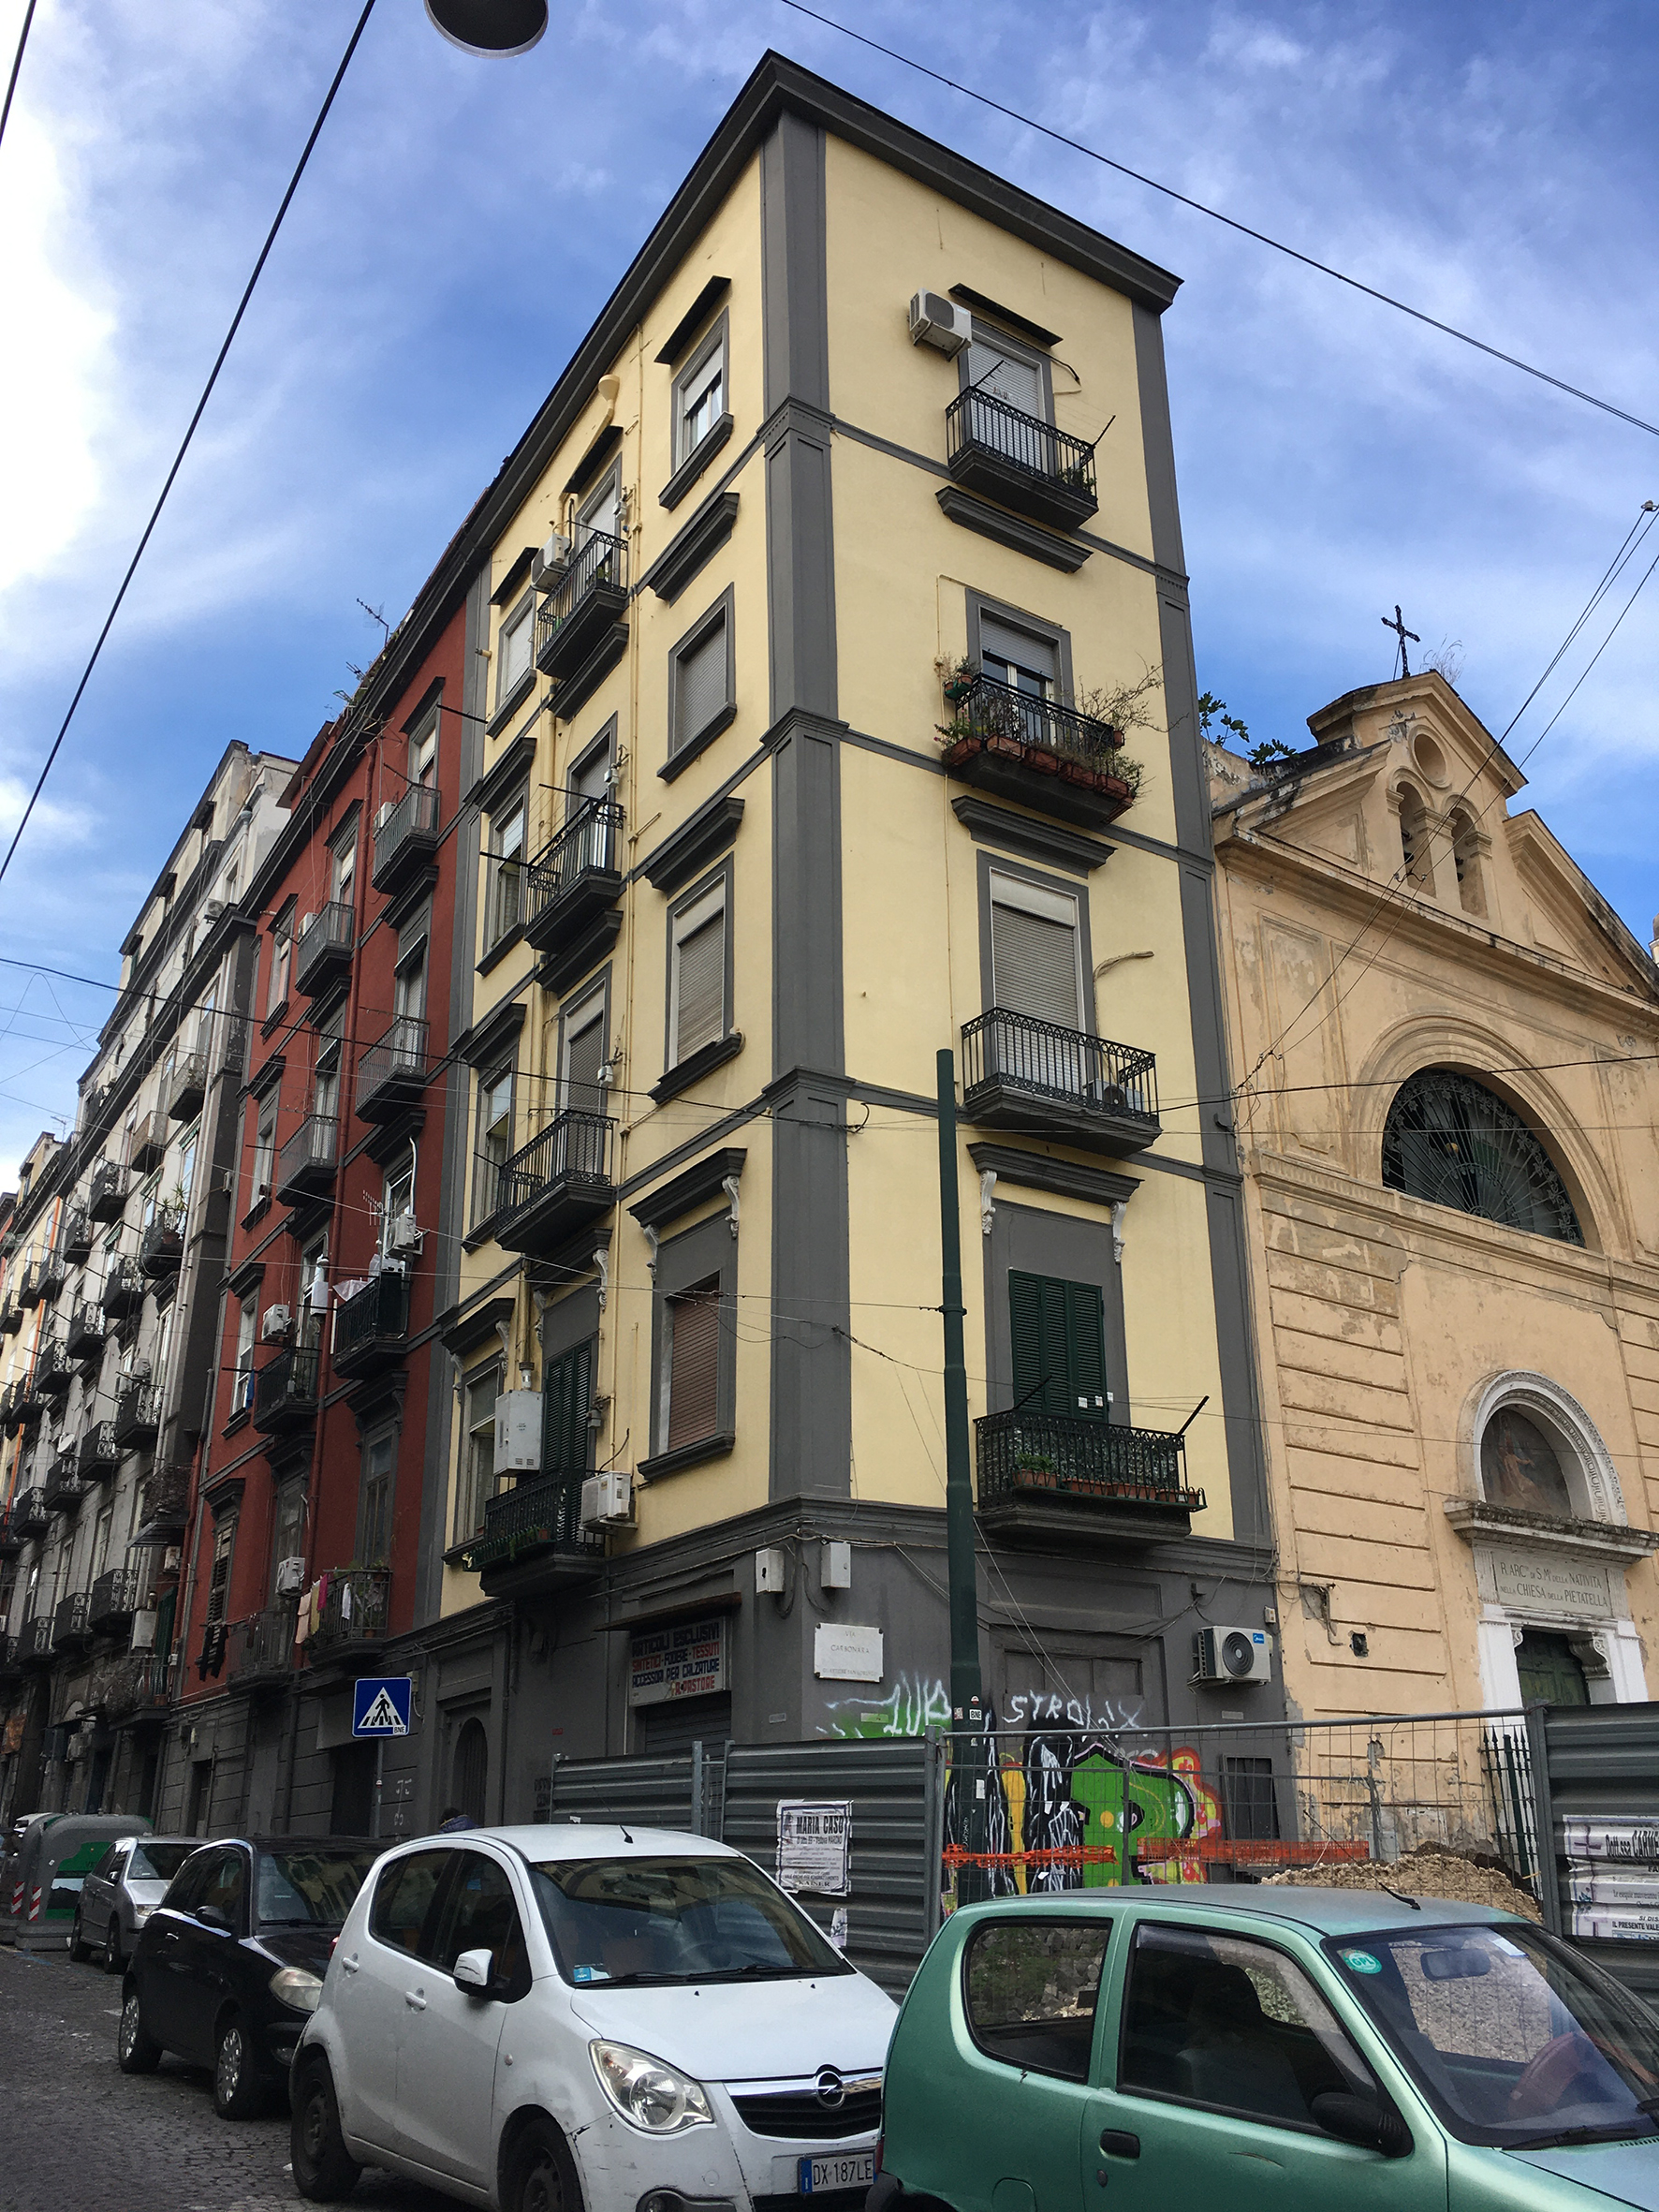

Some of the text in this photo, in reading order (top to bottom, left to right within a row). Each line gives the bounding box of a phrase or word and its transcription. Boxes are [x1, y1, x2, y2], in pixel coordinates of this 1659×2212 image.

[1516, 1583, 1546, 1600] CHIESA
[1564, 1589, 1608, 1607] PIETATELLA
[673, 1622, 720, 1648] ESCLUSIVI
[693, 1642, 720, 1659] TESSUTI
[830, 1644, 870, 1654] CARBONARA
[632, 1658, 720, 1688] ACCESSORI PER CALZATURE
[970, 1710, 981, 1719] BNE
[796, 1815, 844, 1835] MARIA CASO
[1618, 1921, 1645, 1930] PRESENTE
[1352, 1956, 1374, 1966] GPL
[813, 2159, 873, 2186] DX 187LE
